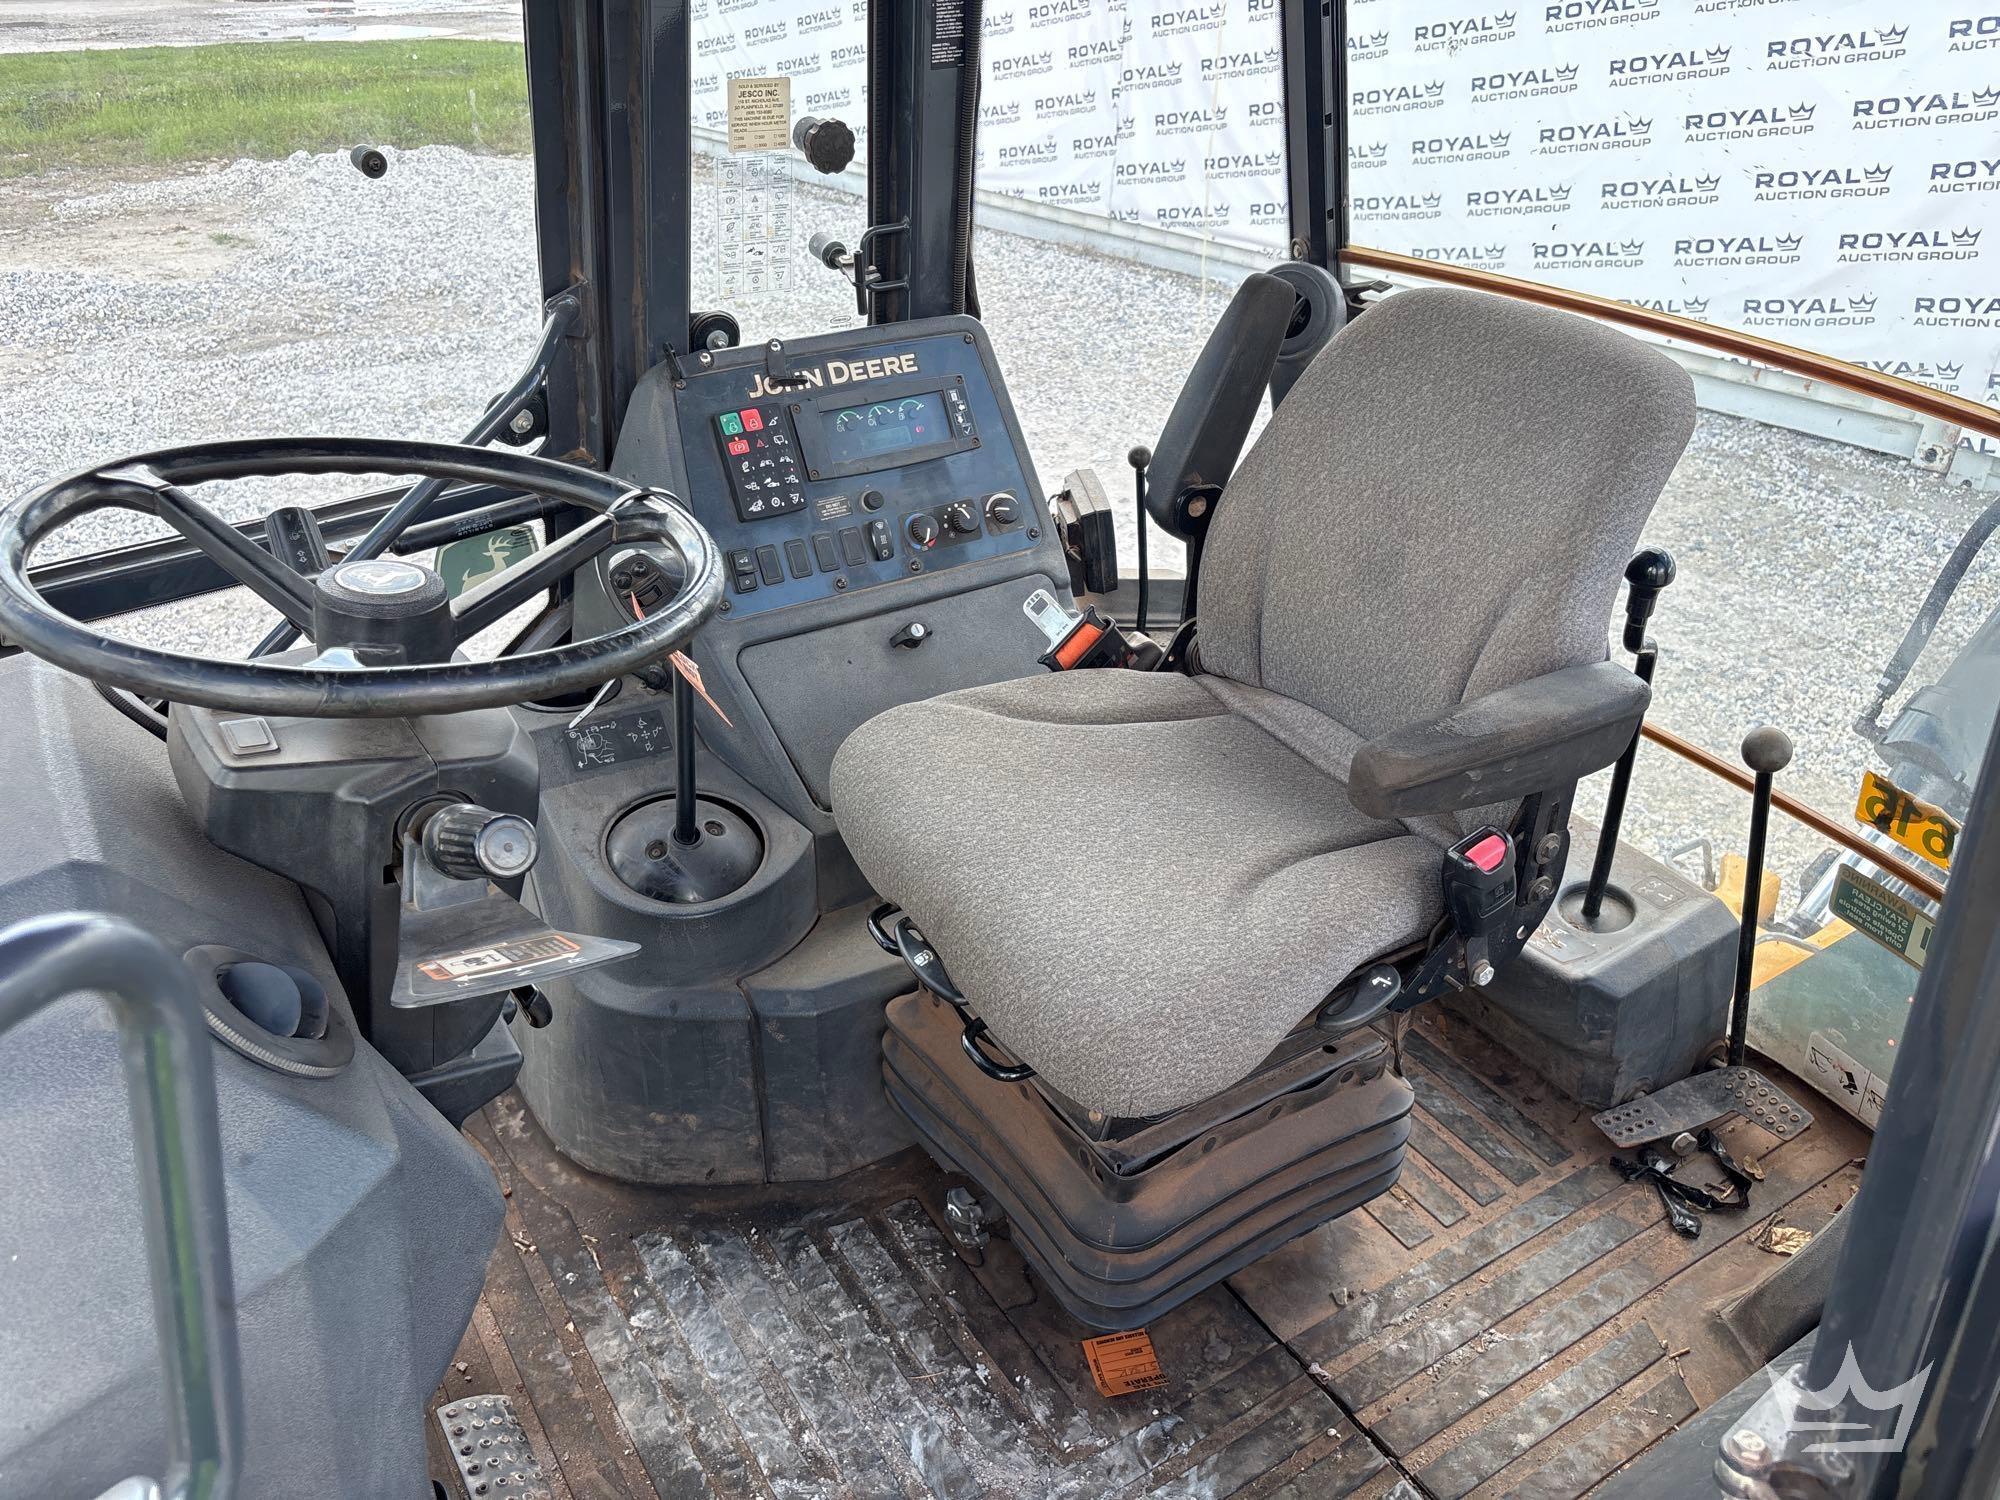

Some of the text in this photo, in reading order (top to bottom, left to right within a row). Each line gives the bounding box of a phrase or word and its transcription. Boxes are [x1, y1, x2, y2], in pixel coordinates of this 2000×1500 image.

[1029, 0, 1078, 19] ROYAL
[1546, 0, 1635, 21] ROYAL
[797, 11, 832, 27] ROYAL
[1151, 8, 1209, 28] ROYAL
[1546, 11, 1660, 33] AUCTION GROUP
[745, 24, 777, 39] ROYAL
[1152, 26, 1190, 39] AUCTION
[1415, 16, 1493, 40] ROYAL
[697, 36, 727, 50] ROYAL
[1471, 31, 1515, 44] GROUP
[1767, 31, 1875, 57] ROYAL
[831, 45, 866, 61] ROYAL
[1069, 40, 1117, 59] ROYAL
[1351, 50, 1388, 61] GROUP
[777, 56, 810, 71] ROYAL
[993, 54, 1039, 72] ROYAL
[1201, 51, 1263, 72] ROYAL
[1610, 51, 1703, 75] ROYAL
[1767, 49, 1906, 71] AUCTION GROUP
[1123, 65, 1167, 81] OYAL
[1472, 69, 1554, 91] ROYAL
[1609, 67, 1730, 87] AUCTION GROUP
[1152, 78, 1182, 88] GROUP
[738, 90, 763, 98] JESCO
[806, 91, 840, 105] ROYAL
[1353, 86, 1423, 105] ROYAL
[1472, 84, 1577, 103] AUCTION GROUP
[1035, 94, 1082, 110] ROYAL
[1353, 100, 1444, 116] AUCTION GROUP
[1853, 92, 1969, 117] ROYAL
[1155, 110, 1212, 126] ROYAL
[1685, 108, 1786, 129] ROYAL
[1853, 111, 1998, 130] AUCTION GROUP
[1156, 122, 1227, 136] AUCTION GROUP
[1540, 122, 1626, 142] ROYAL
[1685, 125, 1814, 143] AUCTION GROUP
[999, 145, 1044, 159] ROYAL
[1412, 135, 1488, 154] ROYAL
[1539, 138, 1651, 155] AUCTION GROUP
[1205, 155, 1264, 170] ROYAL
[1351, 160, 1387, 169] GROUP
[1412, 151, 1510, 165] AUCTION GROUP
[1117, 162, 1170, 176] ROYAL
[1248, 168, 1281, 177] GROUP
[1930, 160, 2000, 180] ROY
[1117, 175, 1186, 185] AUCTION GROUP
[1756, 168, 1860, 188] ROYAL
[1039, 183, 1087, 197] ROYAL
[1602, 178, 1692, 197] ROYAL
[1755, 187, 1890, 201] AUCTION GROUP
[1353, 196, 1420, 210] ROYAL
[1467, 188, 1548, 205] ROYAL
[1601, 196, 1719, 210] AUCTION GROUP
[1158, 207, 1213, 219] ROYAL
[1250, 203, 1287, 216] ROY
[1353, 211, 1441, 220] AUCTION GROUP
[1467, 204, 1570, 217] AUCTION GROUP
[1675, 237, 1773, 254] ROYAL
[1839, 231, 1948, 250] ROYAL
[1412, 247, 1483, 260] ROYAL
[1534, 243, 1618, 258] ROYAL
[1837, 251, 1978, 262] AUCTION GROUP
[1534, 259, 1643, 269] AUCTION GROUP
[1674, 256, 1800, 267] AUCTION GROUP
[1743, 298, 1845, 314] ROYAL
[1915, 297, 2000, 314] ROYA
[1742, 317, 1875, 326] AUCTION GROUP
[1914, 317, 1990, 327] AUCTION
[827, 354, 918, 385] DEERE
